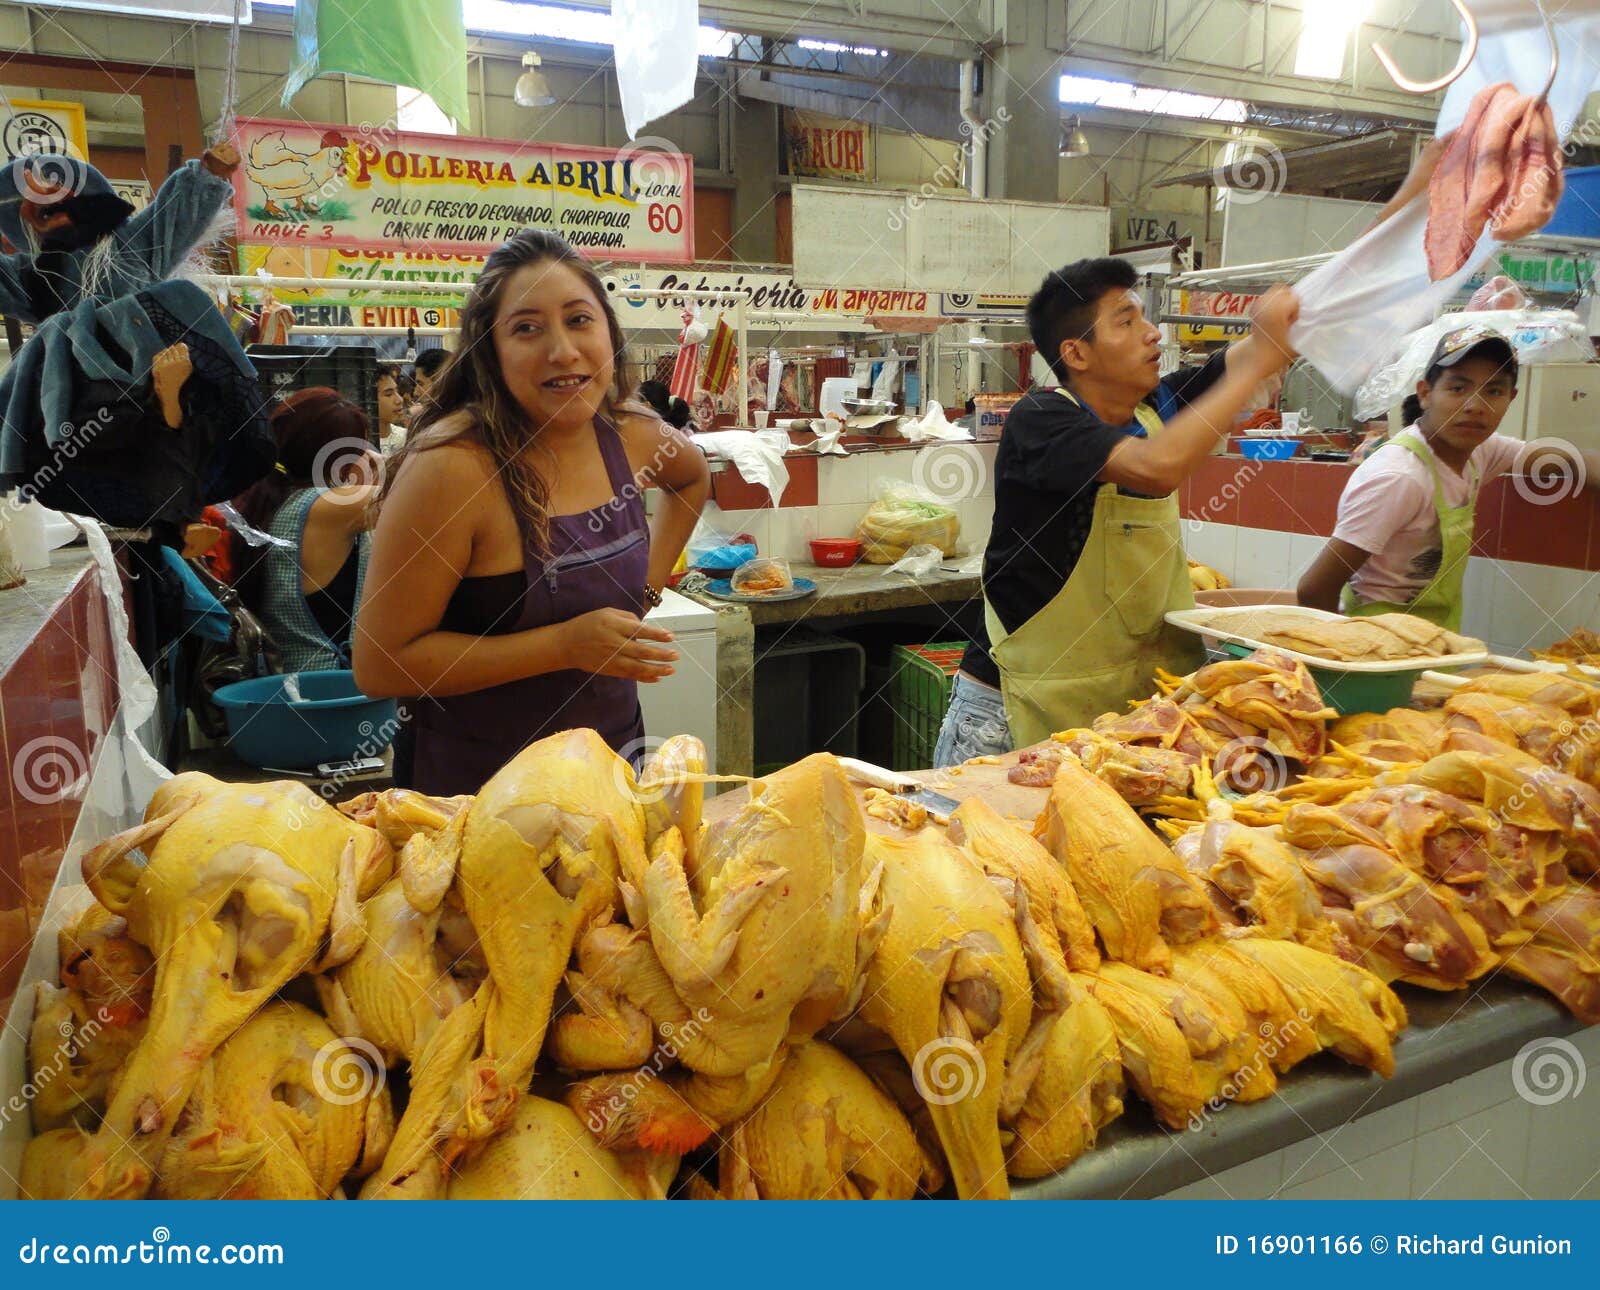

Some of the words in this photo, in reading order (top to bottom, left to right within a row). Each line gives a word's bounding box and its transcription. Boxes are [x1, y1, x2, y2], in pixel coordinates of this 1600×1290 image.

[352, 138, 517, 185] POLLERIA
[527, 159, 641, 201] ABRIL
[644, 181, 682, 198] LOCAL
[371, 197, 421, 216] POLLO
[425, 199, 479, 219] FRESCO
[647, 202, 684, 234] 60
[320, 225, 334, 240] 3
[383, 220, 432, 240] CARNE
[434, 222, 488, 242] MOLIDA
[490, 225, 501, 241] Y
[362, 306, 421, 328] EVITA
